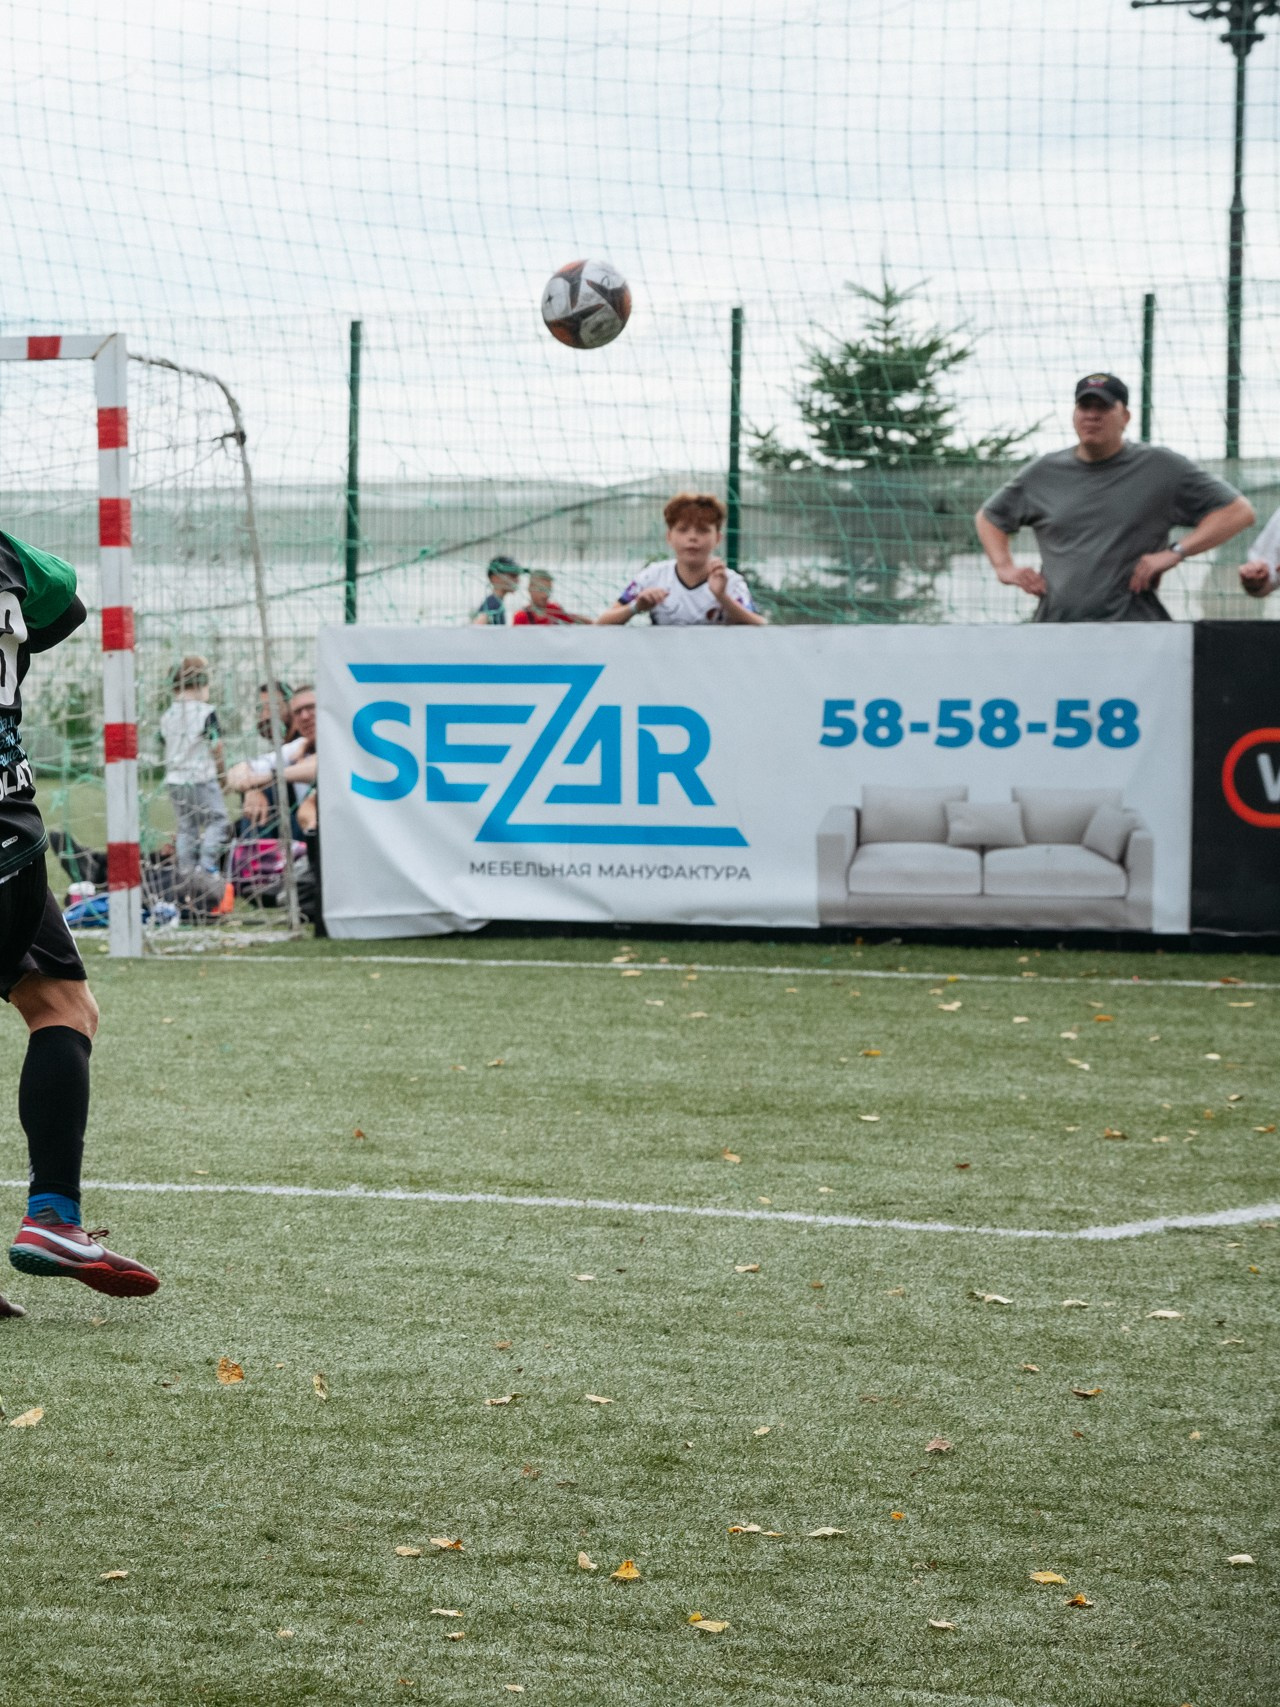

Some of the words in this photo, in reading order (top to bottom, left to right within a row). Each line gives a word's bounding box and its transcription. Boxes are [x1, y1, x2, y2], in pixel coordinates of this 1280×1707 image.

[819, 697, 1140, 749] 58-58-58
[347, 664, 750, 846] SEZAR
[470, 861, 592, 878] МЕБЕЛЬНАЯ
[597, 863, 752, 881] МАНУФАКТУРА
